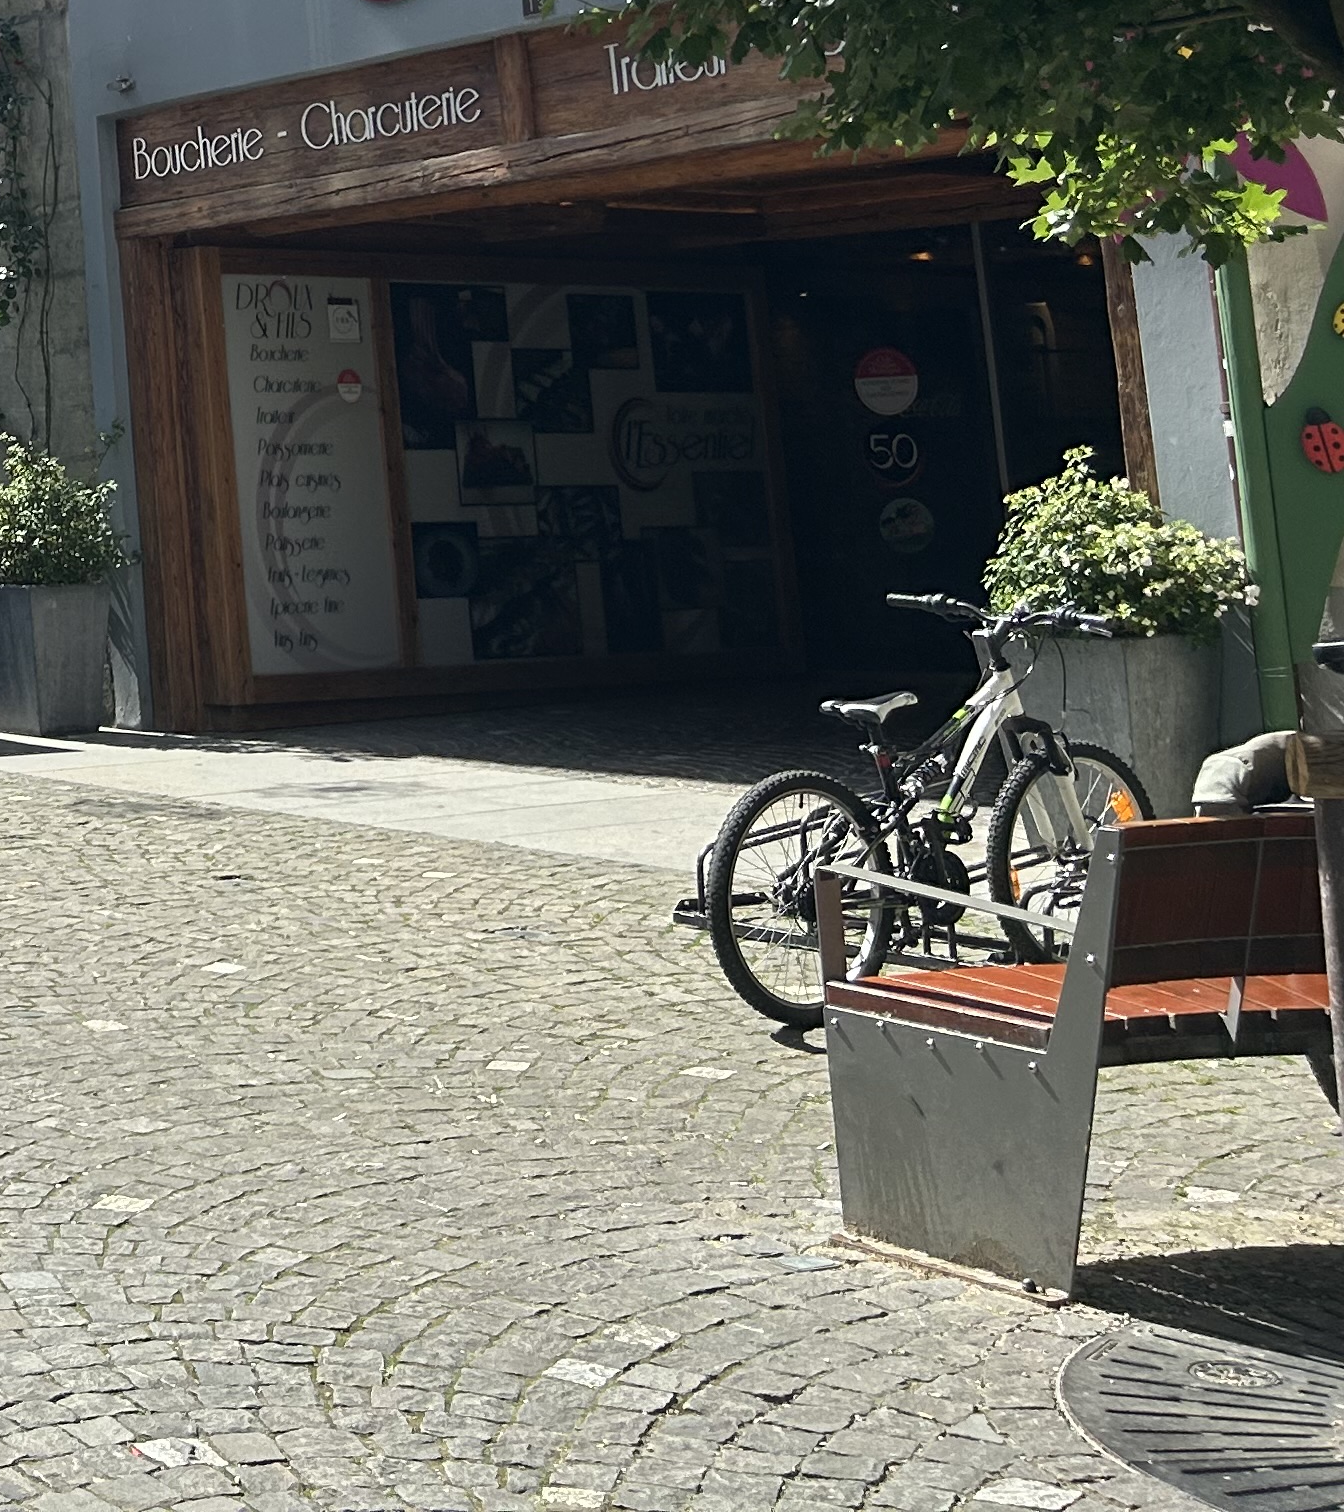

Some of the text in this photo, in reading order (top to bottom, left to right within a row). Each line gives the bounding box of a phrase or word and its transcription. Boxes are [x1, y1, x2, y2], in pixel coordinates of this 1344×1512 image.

[133, 126, 264, 180] Boucherie
[300, 87, 481, 150] Charcuterie
[250, 344, 309, 362] Boucherie
[869, 433, 918, 469] 50
